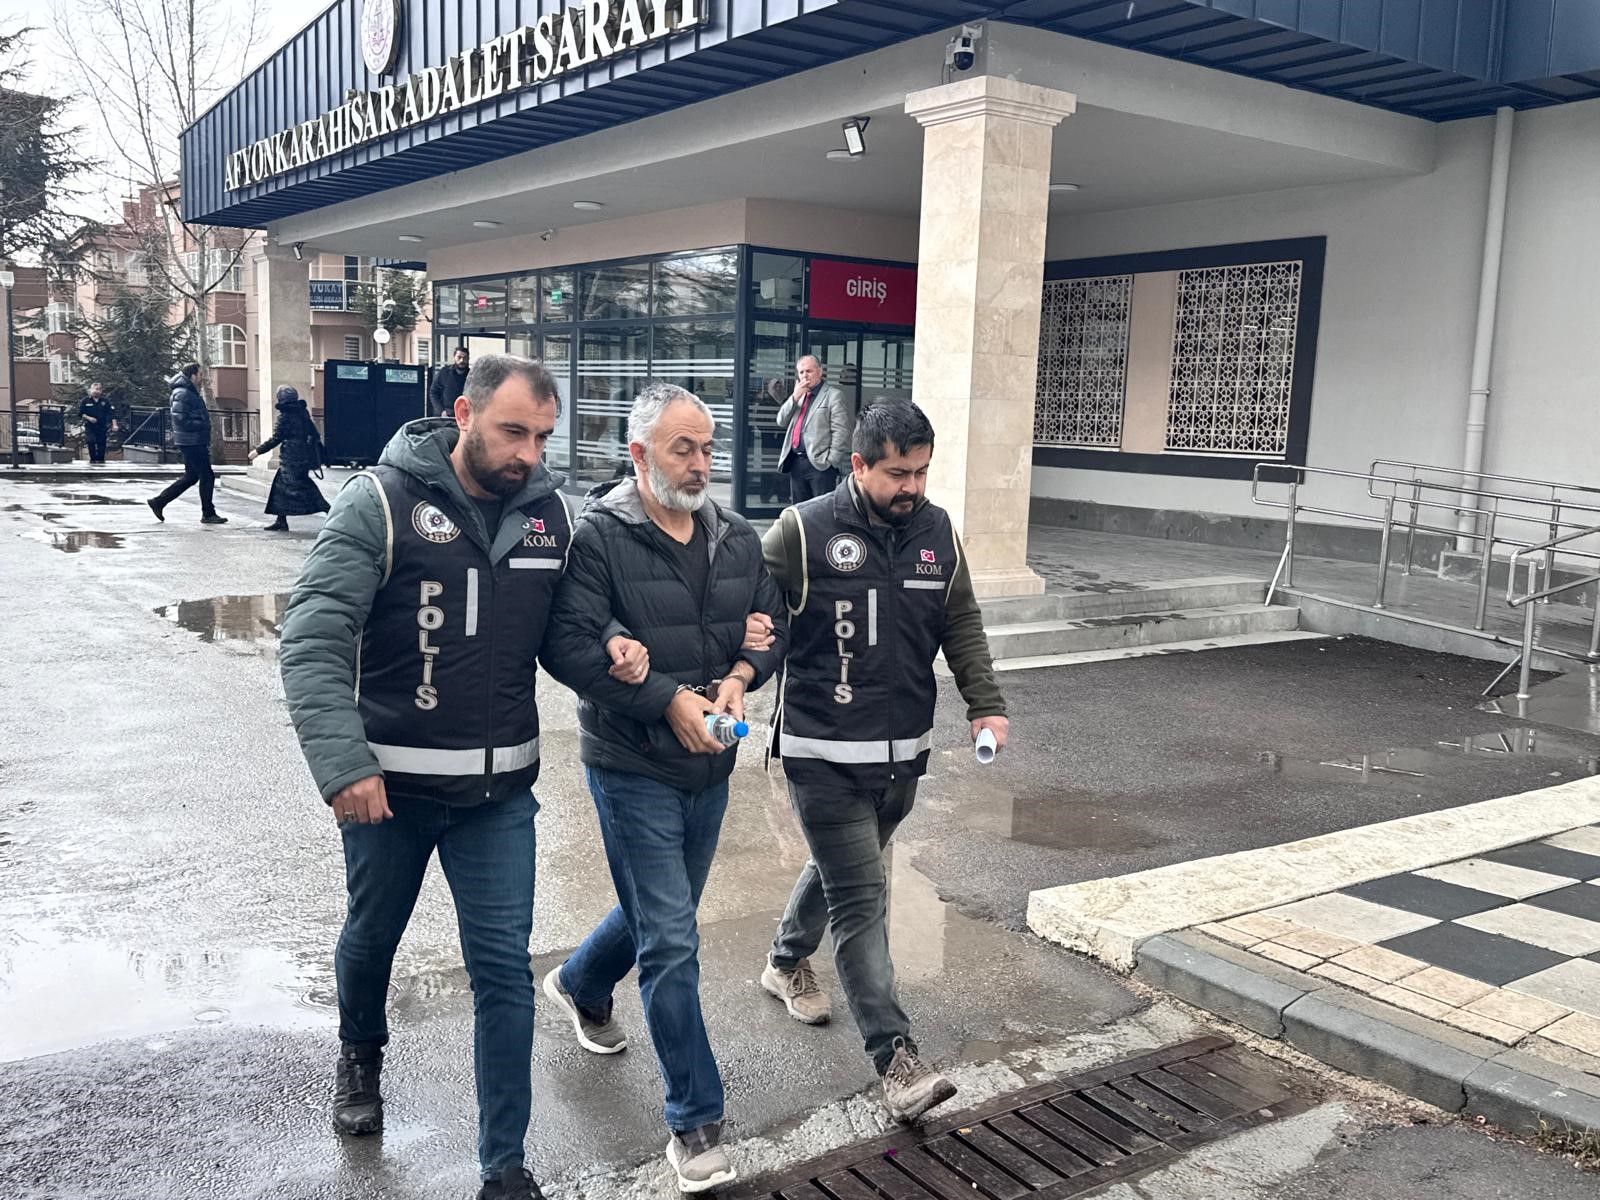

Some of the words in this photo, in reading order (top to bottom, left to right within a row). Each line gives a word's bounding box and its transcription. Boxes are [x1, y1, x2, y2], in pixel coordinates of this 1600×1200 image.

[224, 85, 398, 193] AFYONKARAHİSAR
[400, 26, 527, 128] ADALET
[310, 283, 342, 293] VUKAT
[846, 275, 887, 304] GİRİŞ
[523, 535, 557, 547] KOM
[915, 563, 942, 575] KOM
[415, 580, 445, 710] POLİS
[833, 600, 856, 704] POLİS
